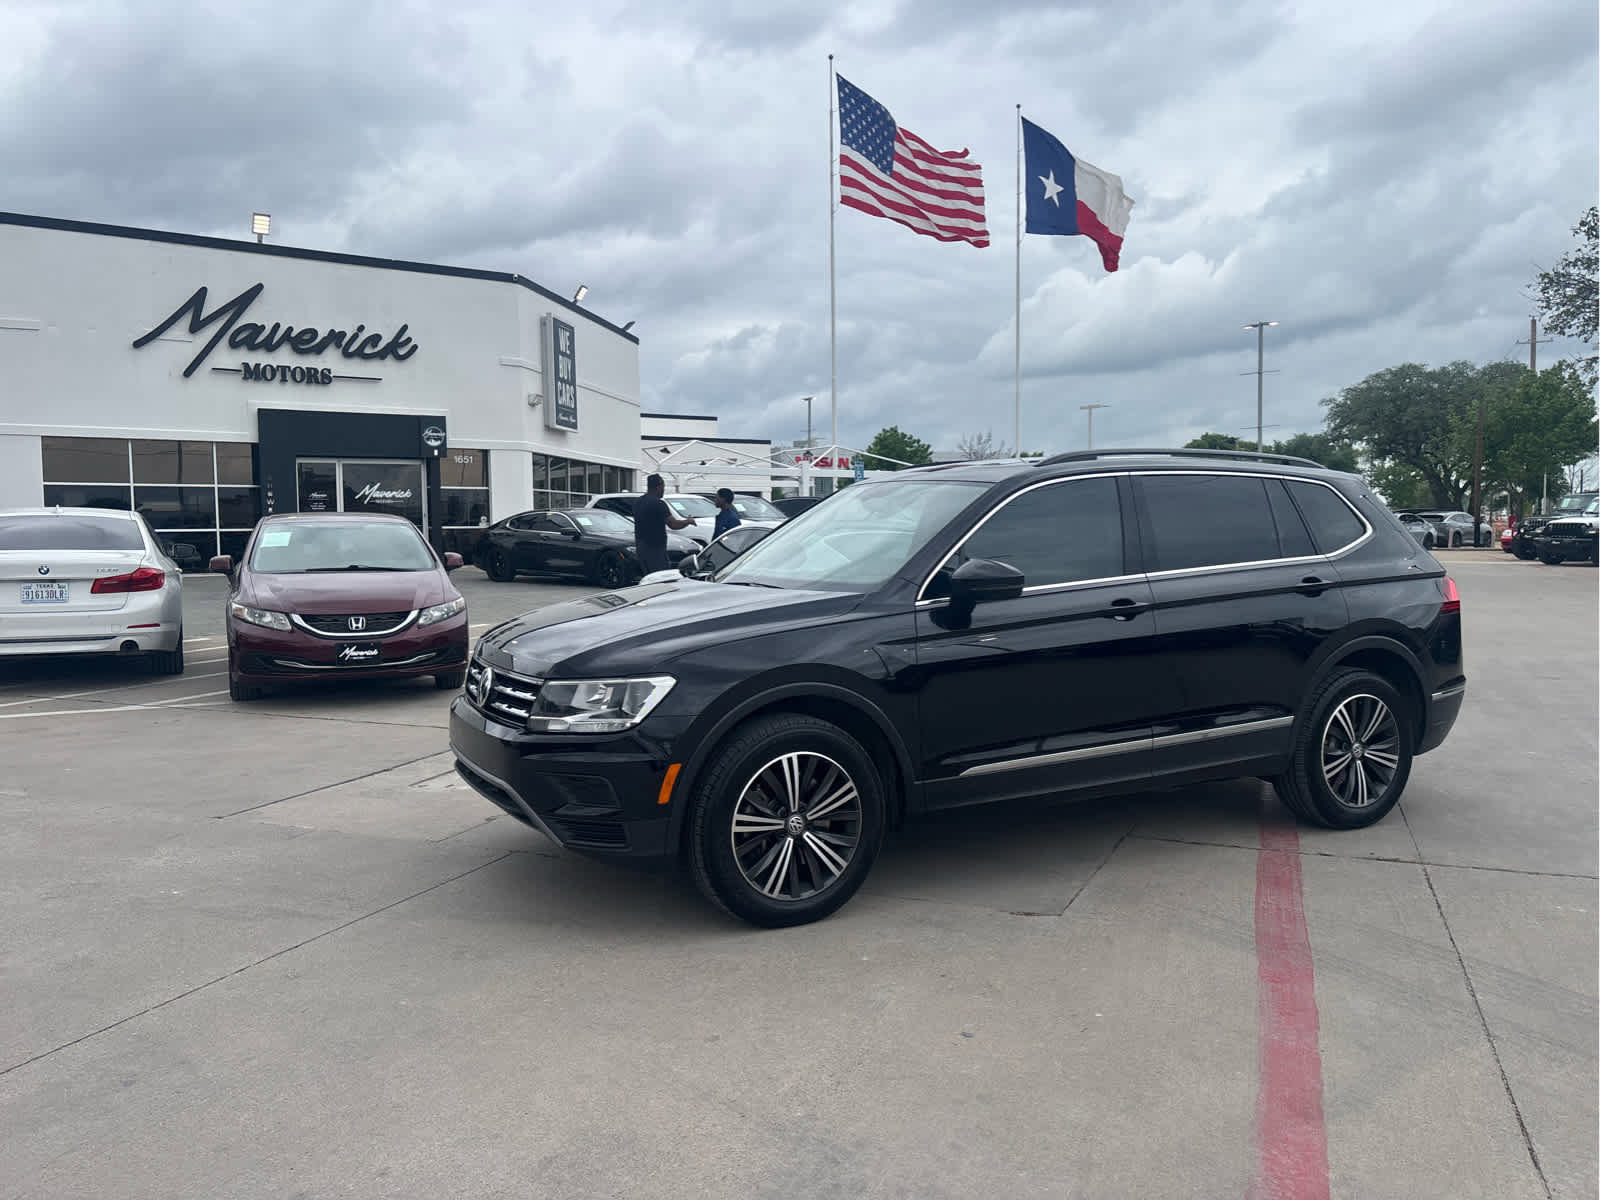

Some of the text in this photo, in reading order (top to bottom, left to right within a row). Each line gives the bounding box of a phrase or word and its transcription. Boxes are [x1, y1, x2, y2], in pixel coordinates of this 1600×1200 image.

[132, 282, 419, 378] Maverick
[558, 327, 571, 355] WE
[241, 362, 333, 385] MOTORS
[558, 354, 572, 382] BUY
[557, 381, 575, 409] CARS
[454, 455, 473, 464] 1651
[354, 482, 413, 505] Maverick
